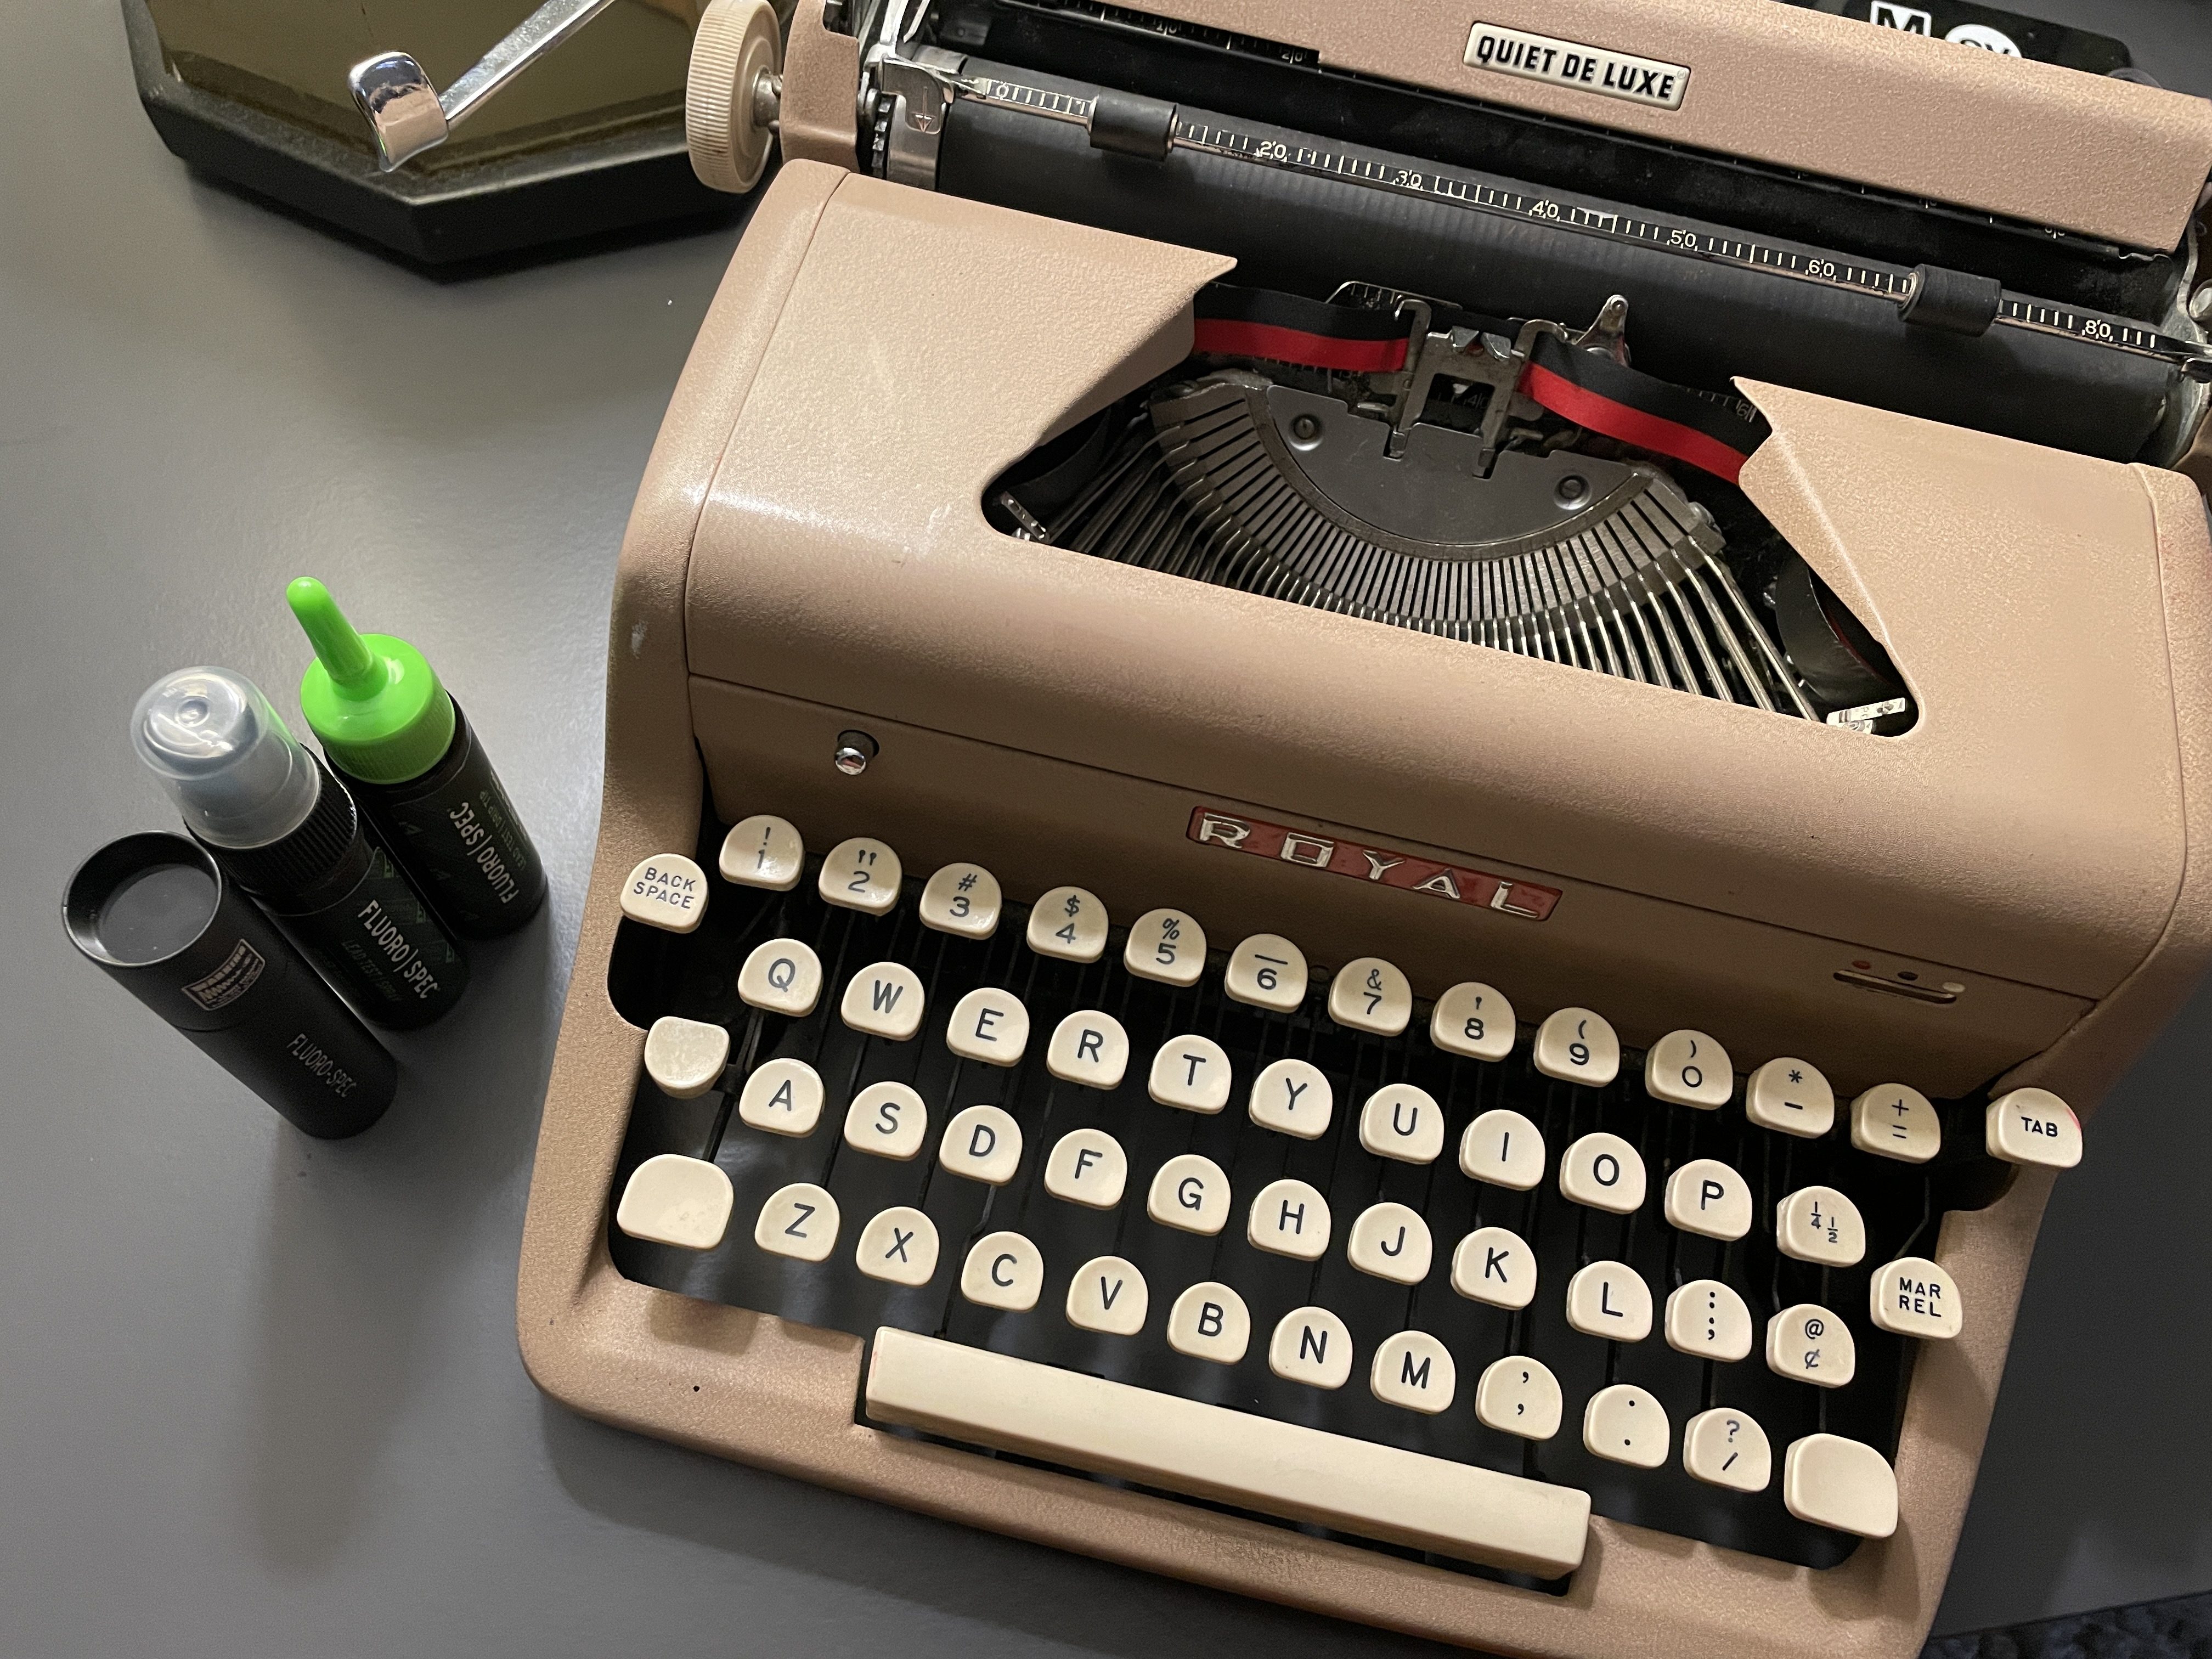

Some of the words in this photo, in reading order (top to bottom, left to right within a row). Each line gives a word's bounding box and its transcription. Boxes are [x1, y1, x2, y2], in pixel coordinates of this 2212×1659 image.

[1477, 35, 1557, 74] QUIET
[1561, 54, 1596, 82] DE
[1603, 63, 1674, 98] LUXE
[1398, 170, 1422, 188] 30
[1532, 200, 1559, 218] 40
[1671, 229, 1697, 247] 50
[1808, 259, 1835, 277] 60
[2085, 320, 2112, 338] 80
[644, 867, 696, 891] BACK
[1199, 812, 1539, 918] ROYAL
[633, 881, 695, 909] SPACE
[848, 870, 870, 893] 2
[958, 873, 978, 892] #
[949, 896, 970, 917] 3
[1064, 895, 1080, 917] $
[1055, 922, 1076, 944] 4
[1162, 918, 1180, 940] %
[1155, 942, 1177, 964] 5
[768, 958, 795, 992] Q
[1257, 968, 1277, 990] 6
[1367, 968, 1382, 991] &
[873, 979, 904, 1014] W
[1363, 991, 1382, 1015] 7
[975, 1008, 1004, 1041] E
[1464, 1017, 1484, 1040] 8
[1077, 1029, 1103, 1063] R
[1569, 1042, 1590, 1066] 9
[1183, 1054, 1206, 1086] T
[768, 1079, 792, 1111] A
[1285, 1077, 1308, 1110] Y
[875, 1102, 901, 1134] S
[1393, 1103, 1418, 1136] U
[2021, 1116, 2058, 1137] TAB
[969, 1124, 996, 1157] D
[1074, 1149, 1103, 1180] F
[1593, 1154, 1620, 1187] O
[1178, 1177, 1204, 1211] G
[1701, 1180, 1724, 1210] P
[785, 1203, 816, 1238] Z
[1279, 1199, 1305, 1234] H
[885, 1227, 914, 1263] X
[1381, 1226, 1406, 1256] J
[991, 1253, 1017, 1287] C
[1485, 1247, 1509, 1283] K
[1101, 1276, 1123, 1310] V
[1601, 1282, 1623, 1317] L
[1899, 1277, 1941, 1299] MAR
[1198, 1302, 1223, 1337] B
[1899, 1295, 1942, 1318] REL
[1804, 1318, 1824, 1340] @
[1300, 1325, 1328, 1364] N
[1401, 1351, 1431, 1389] M
[1726, 1420, 1740, 1443] ?
